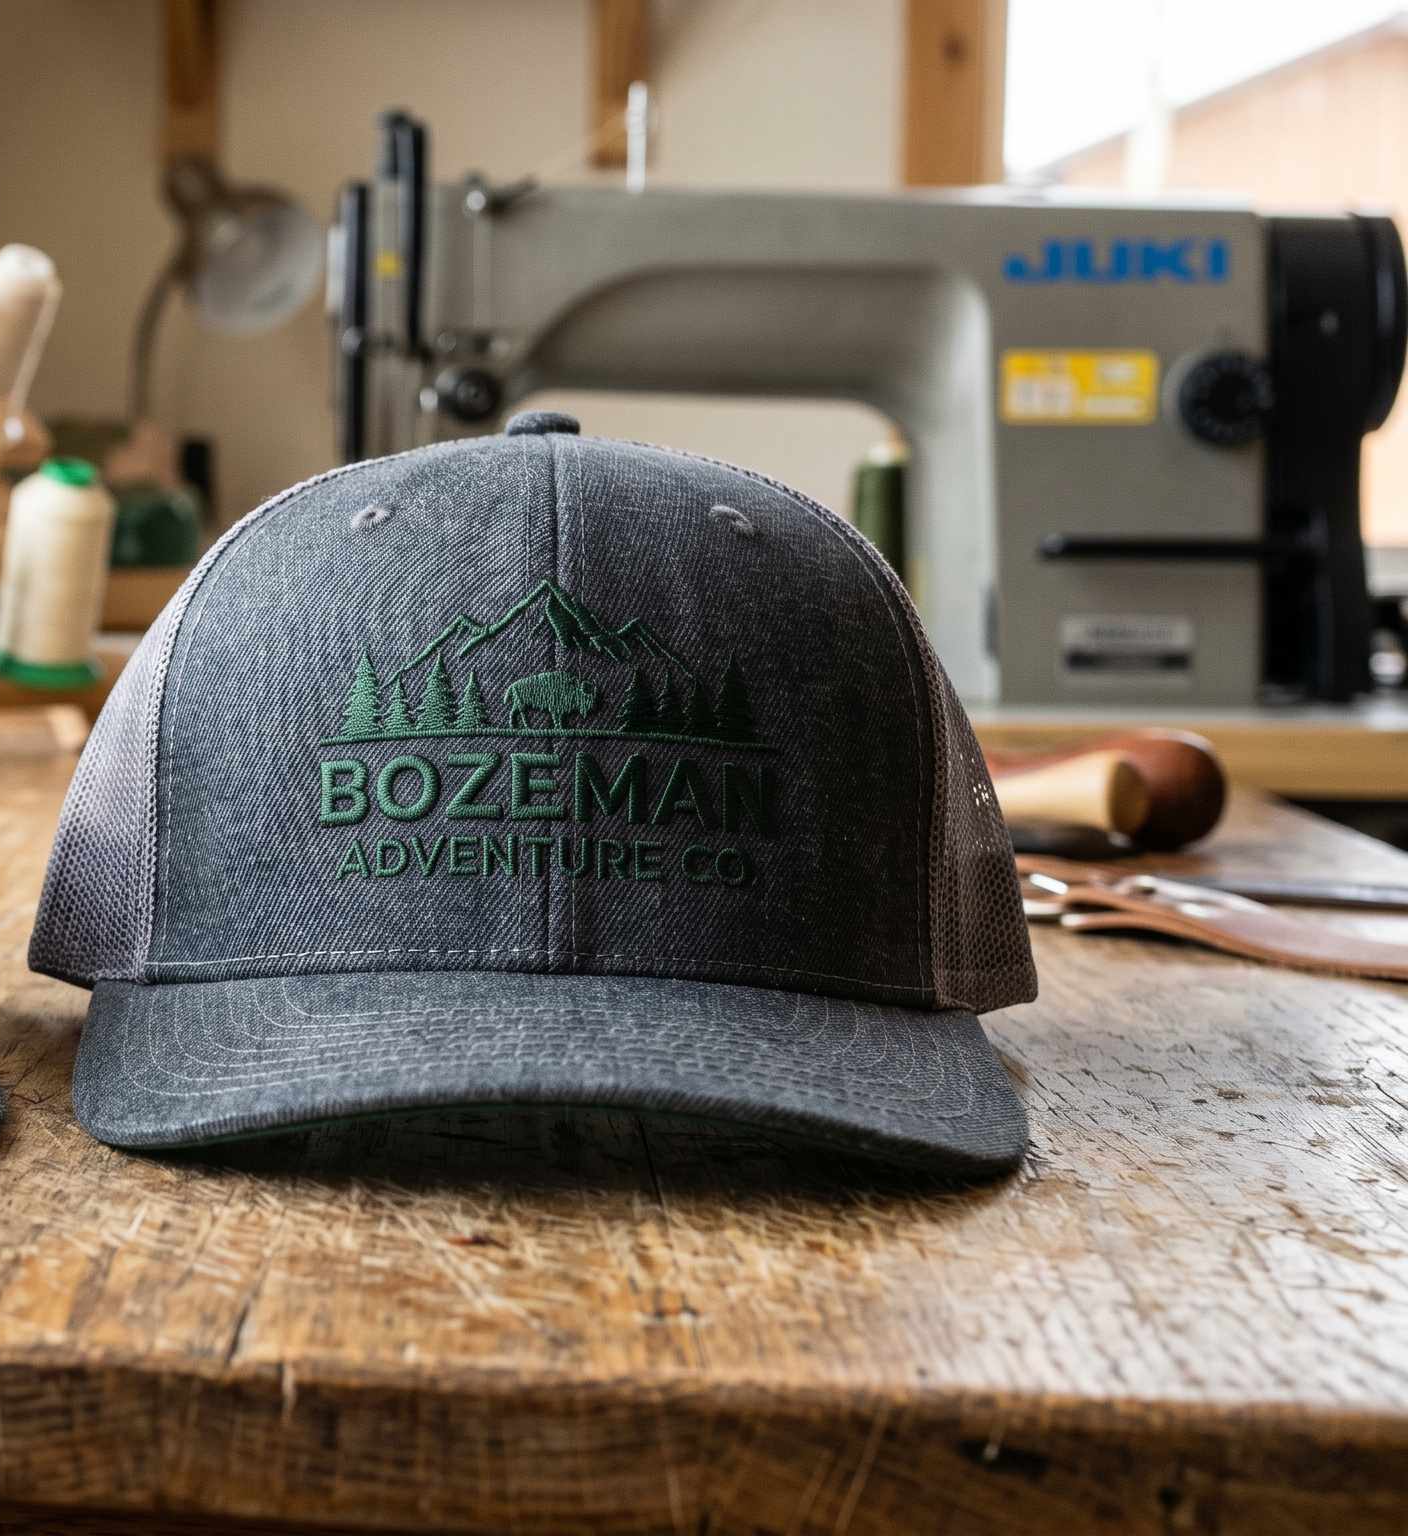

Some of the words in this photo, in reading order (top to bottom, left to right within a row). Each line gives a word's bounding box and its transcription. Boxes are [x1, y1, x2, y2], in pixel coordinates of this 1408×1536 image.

[1003, 238, 1230, 282] JUKI
[319, 752, 774, 832] BOZEMAN
[336, 834, 662, 880] ADVENTURE
